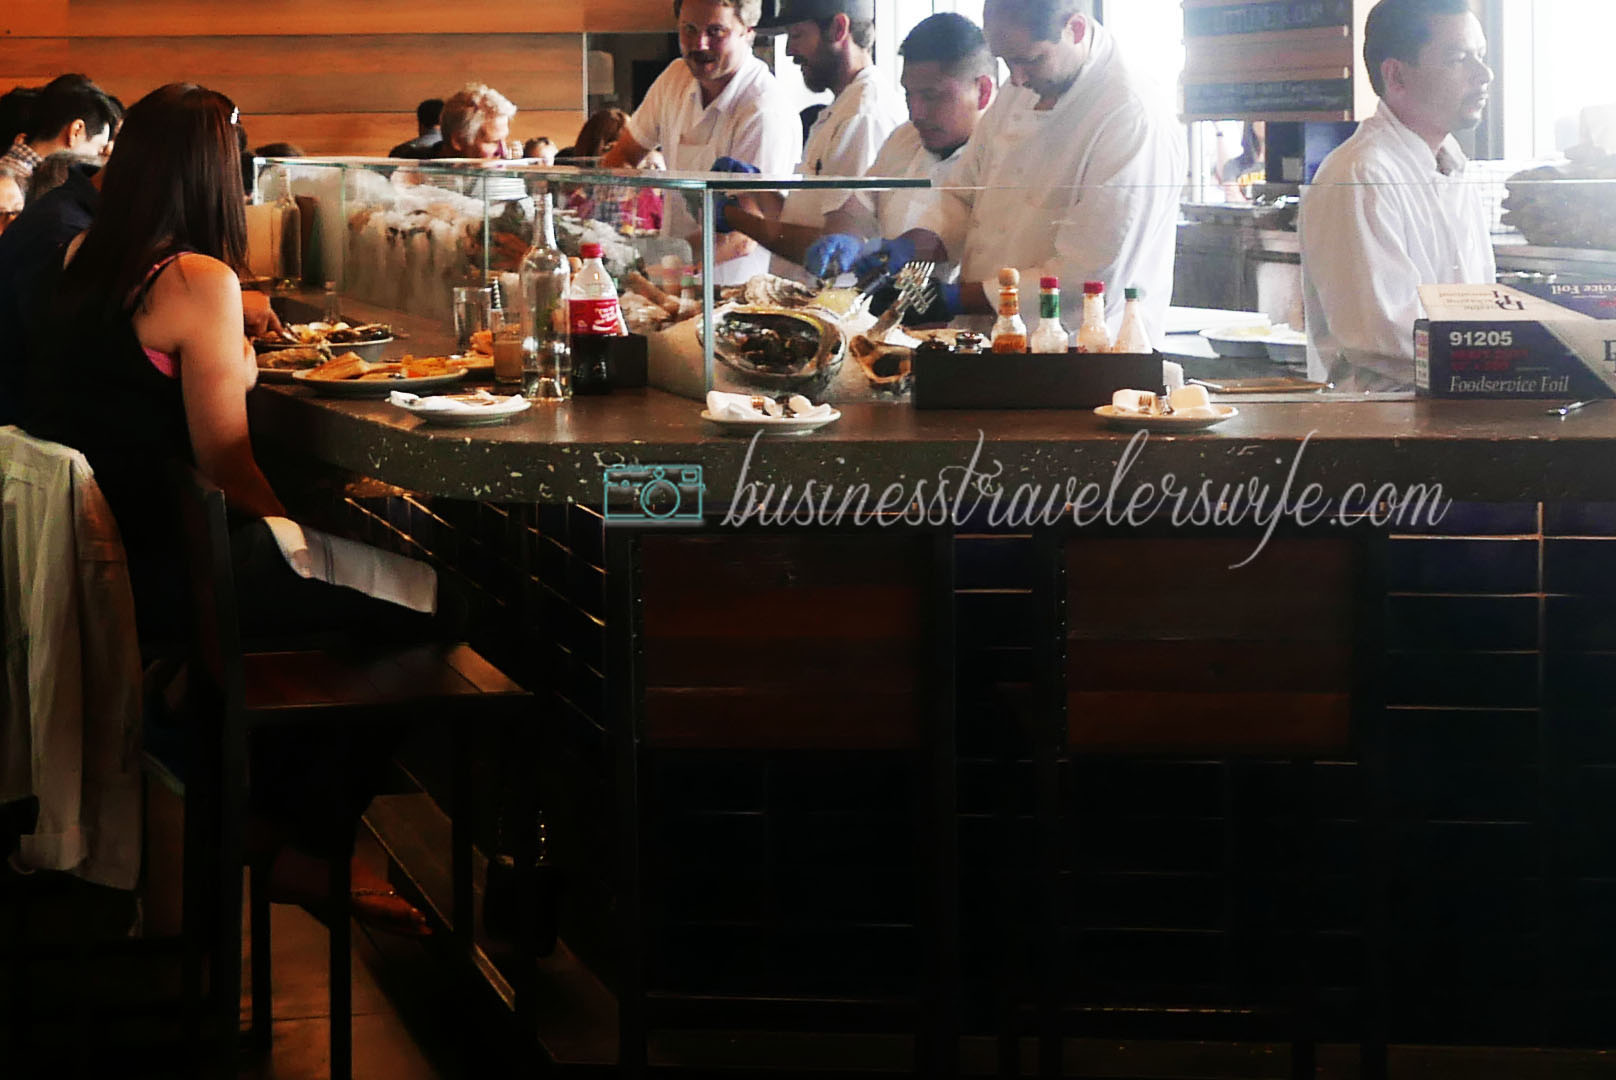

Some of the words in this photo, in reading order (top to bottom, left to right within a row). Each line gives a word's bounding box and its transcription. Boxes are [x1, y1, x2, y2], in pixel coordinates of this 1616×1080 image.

[1449, 331, 1513, 347] 91205
[1449, 375, 1536, 394] Foodservice
[1541, 375, 1570, 393] Foil
